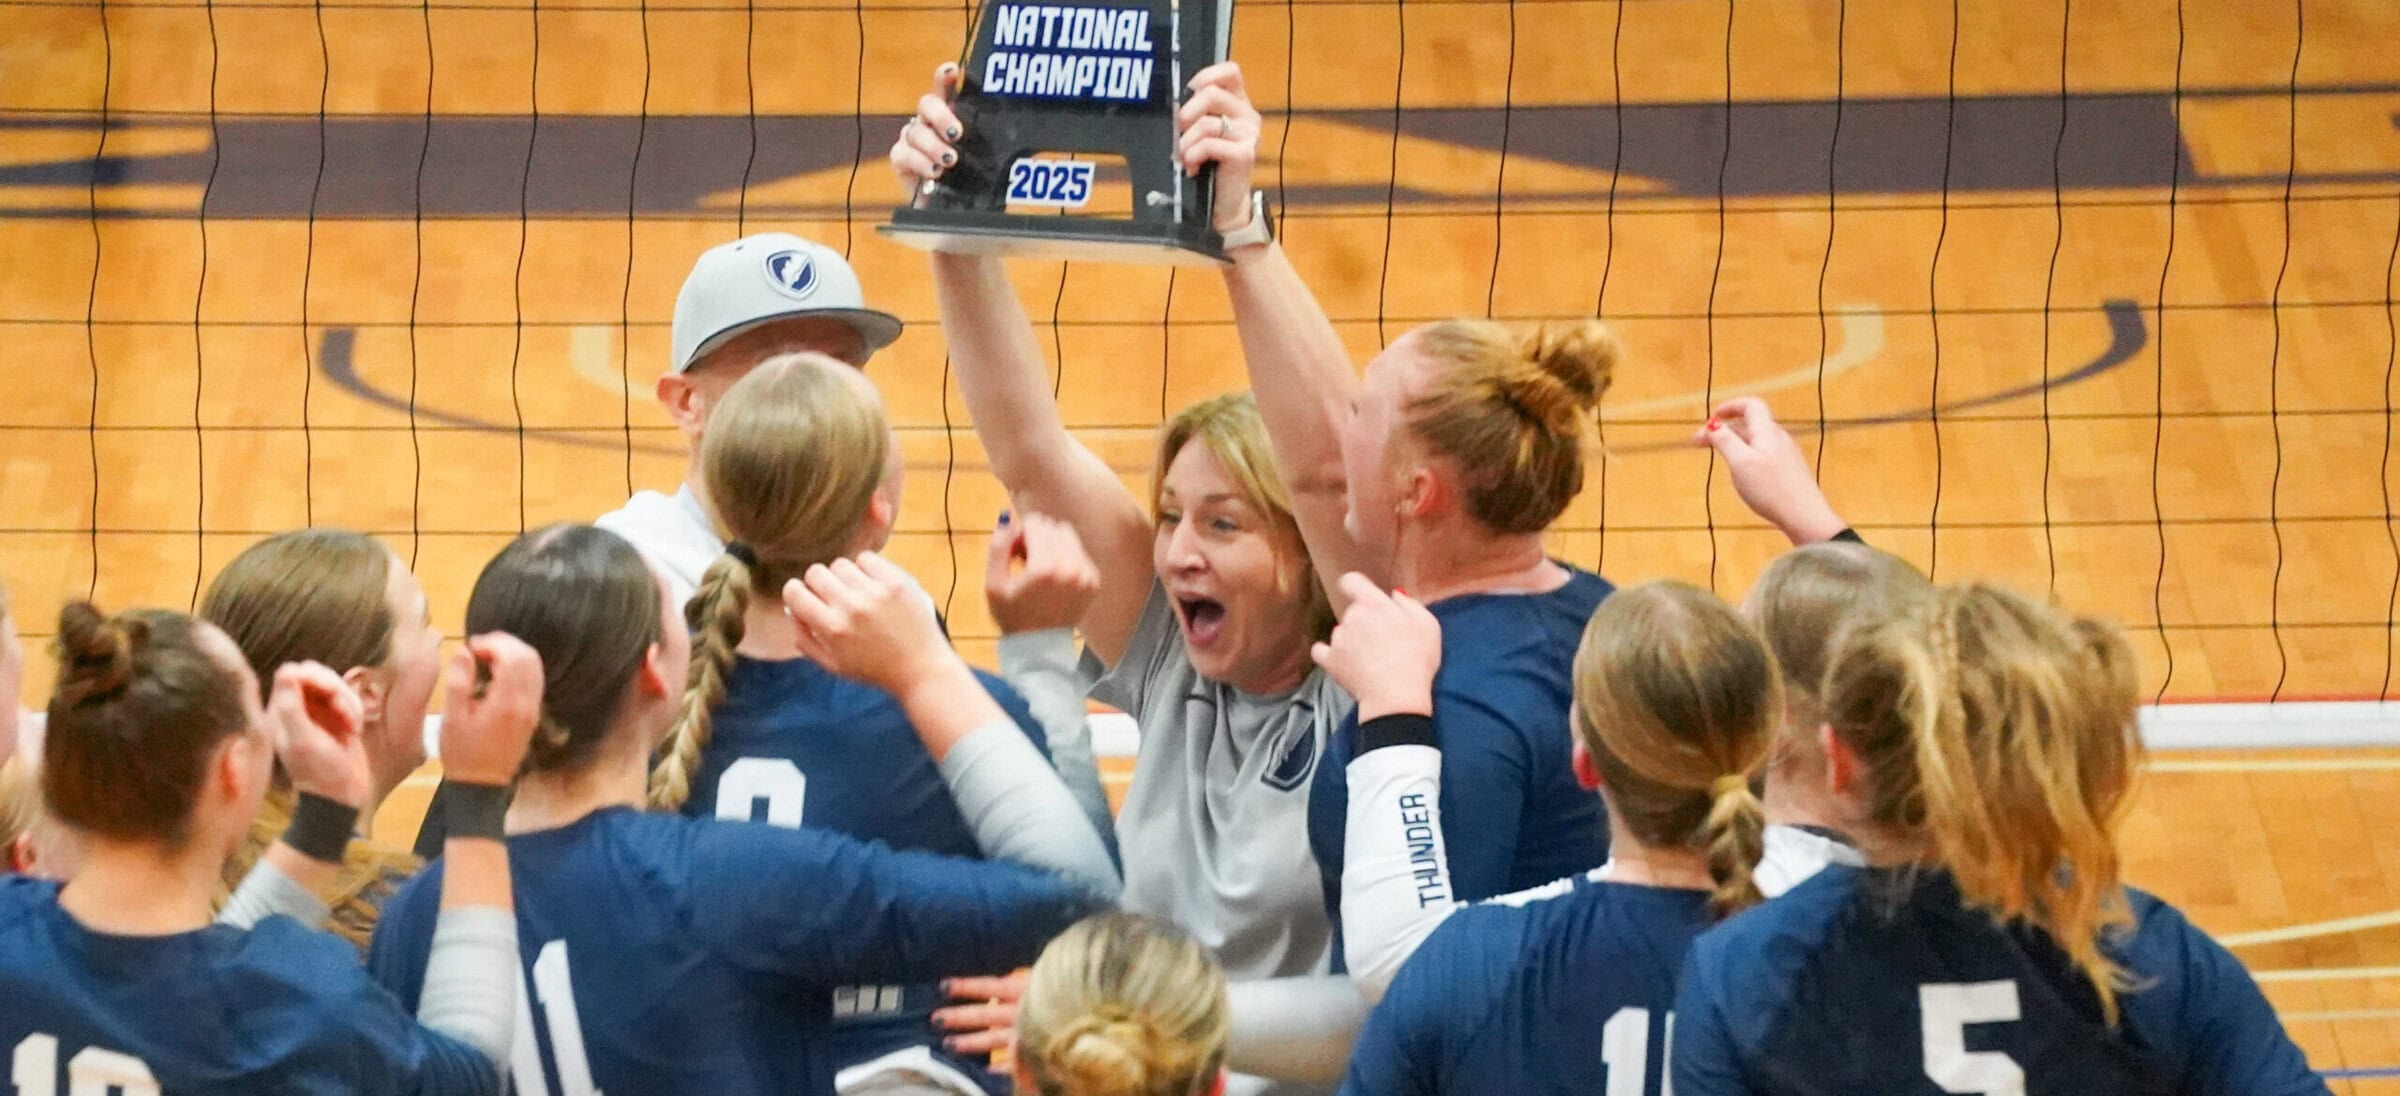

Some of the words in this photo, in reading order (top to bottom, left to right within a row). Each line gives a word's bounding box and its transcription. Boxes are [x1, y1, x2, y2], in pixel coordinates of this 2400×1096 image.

[994, 5, 1153, 51] NATIONAL
[983, 53, 1153, 99] CHAMPION
[1011, 164, 1091, 201] 2025
[1400, 793, 1445, 908] THUNDER
[1601, 1006, 1675, 1096] 1
[1918, 978, 2026, 1096] 5
